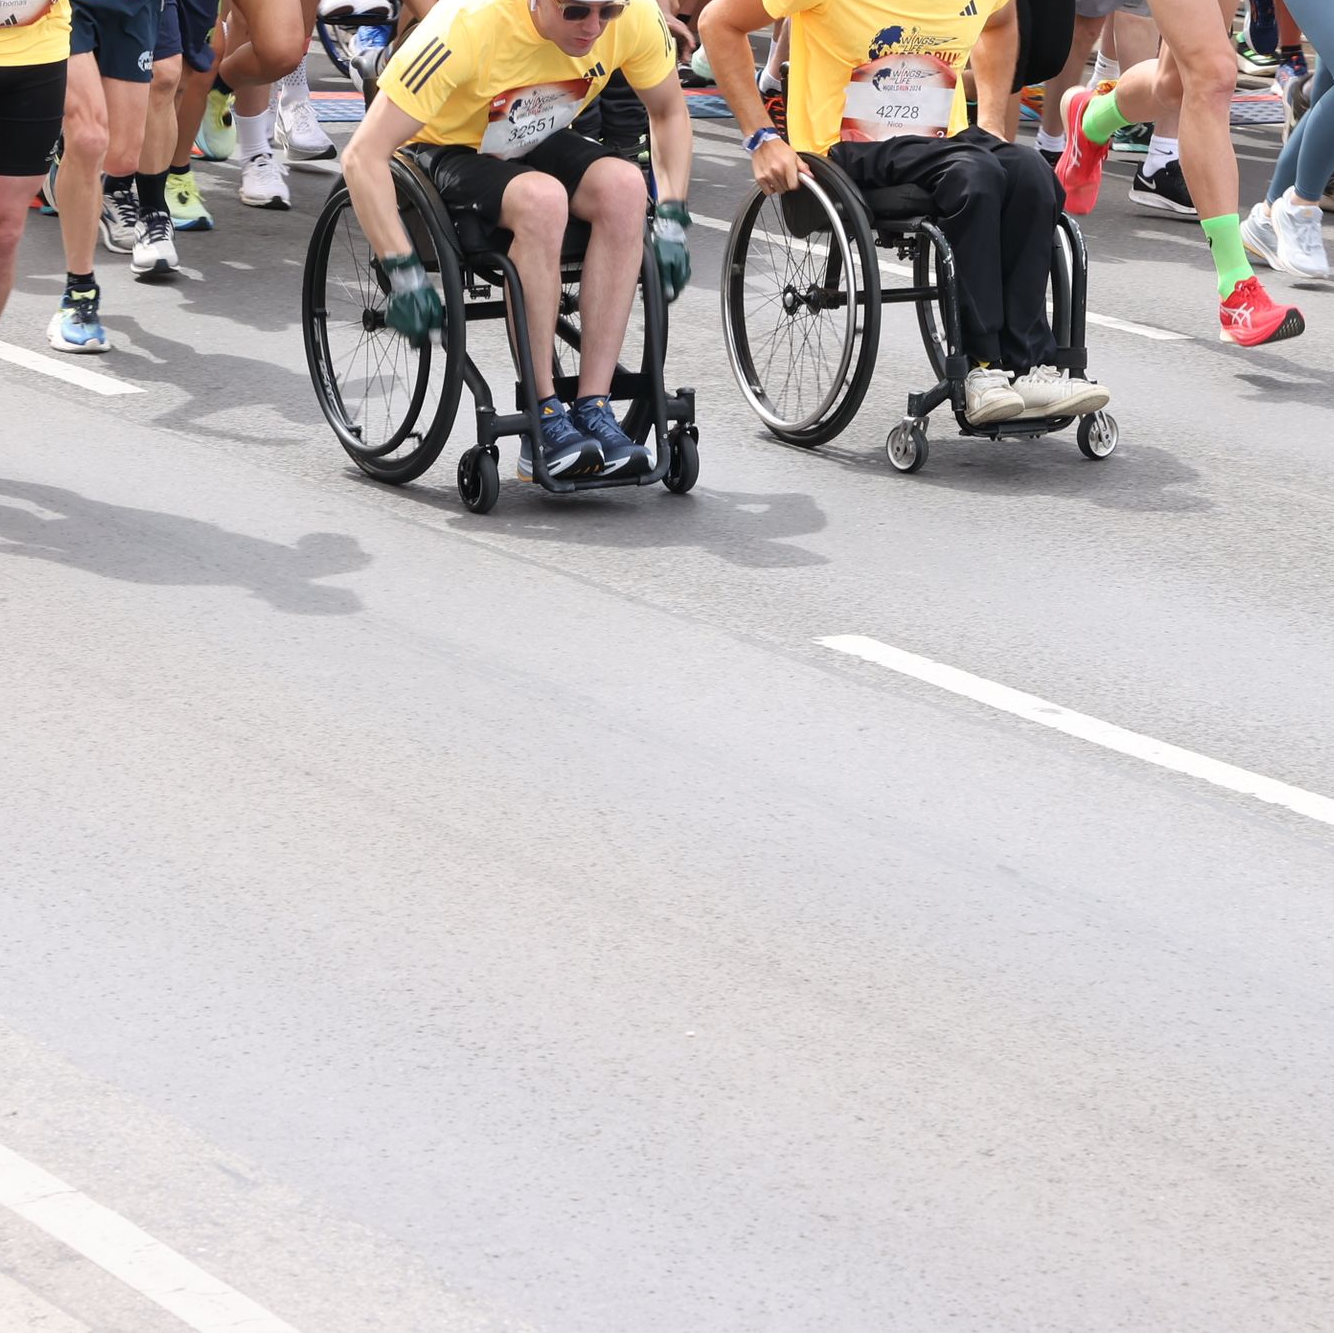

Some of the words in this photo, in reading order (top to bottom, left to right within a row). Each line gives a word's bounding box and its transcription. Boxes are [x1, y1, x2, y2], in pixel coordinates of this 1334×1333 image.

[900, 36, 936, 45] WINGS
[904, 43, 925, 52] LIFE
[892, 70, 922, 78] WINGS
[895, 77, 912, 85] LIFE
[875, 105, 919, 119] 42728
[887, 119, 903, 128] Nico
[507, 115, 556, 144] 32551
